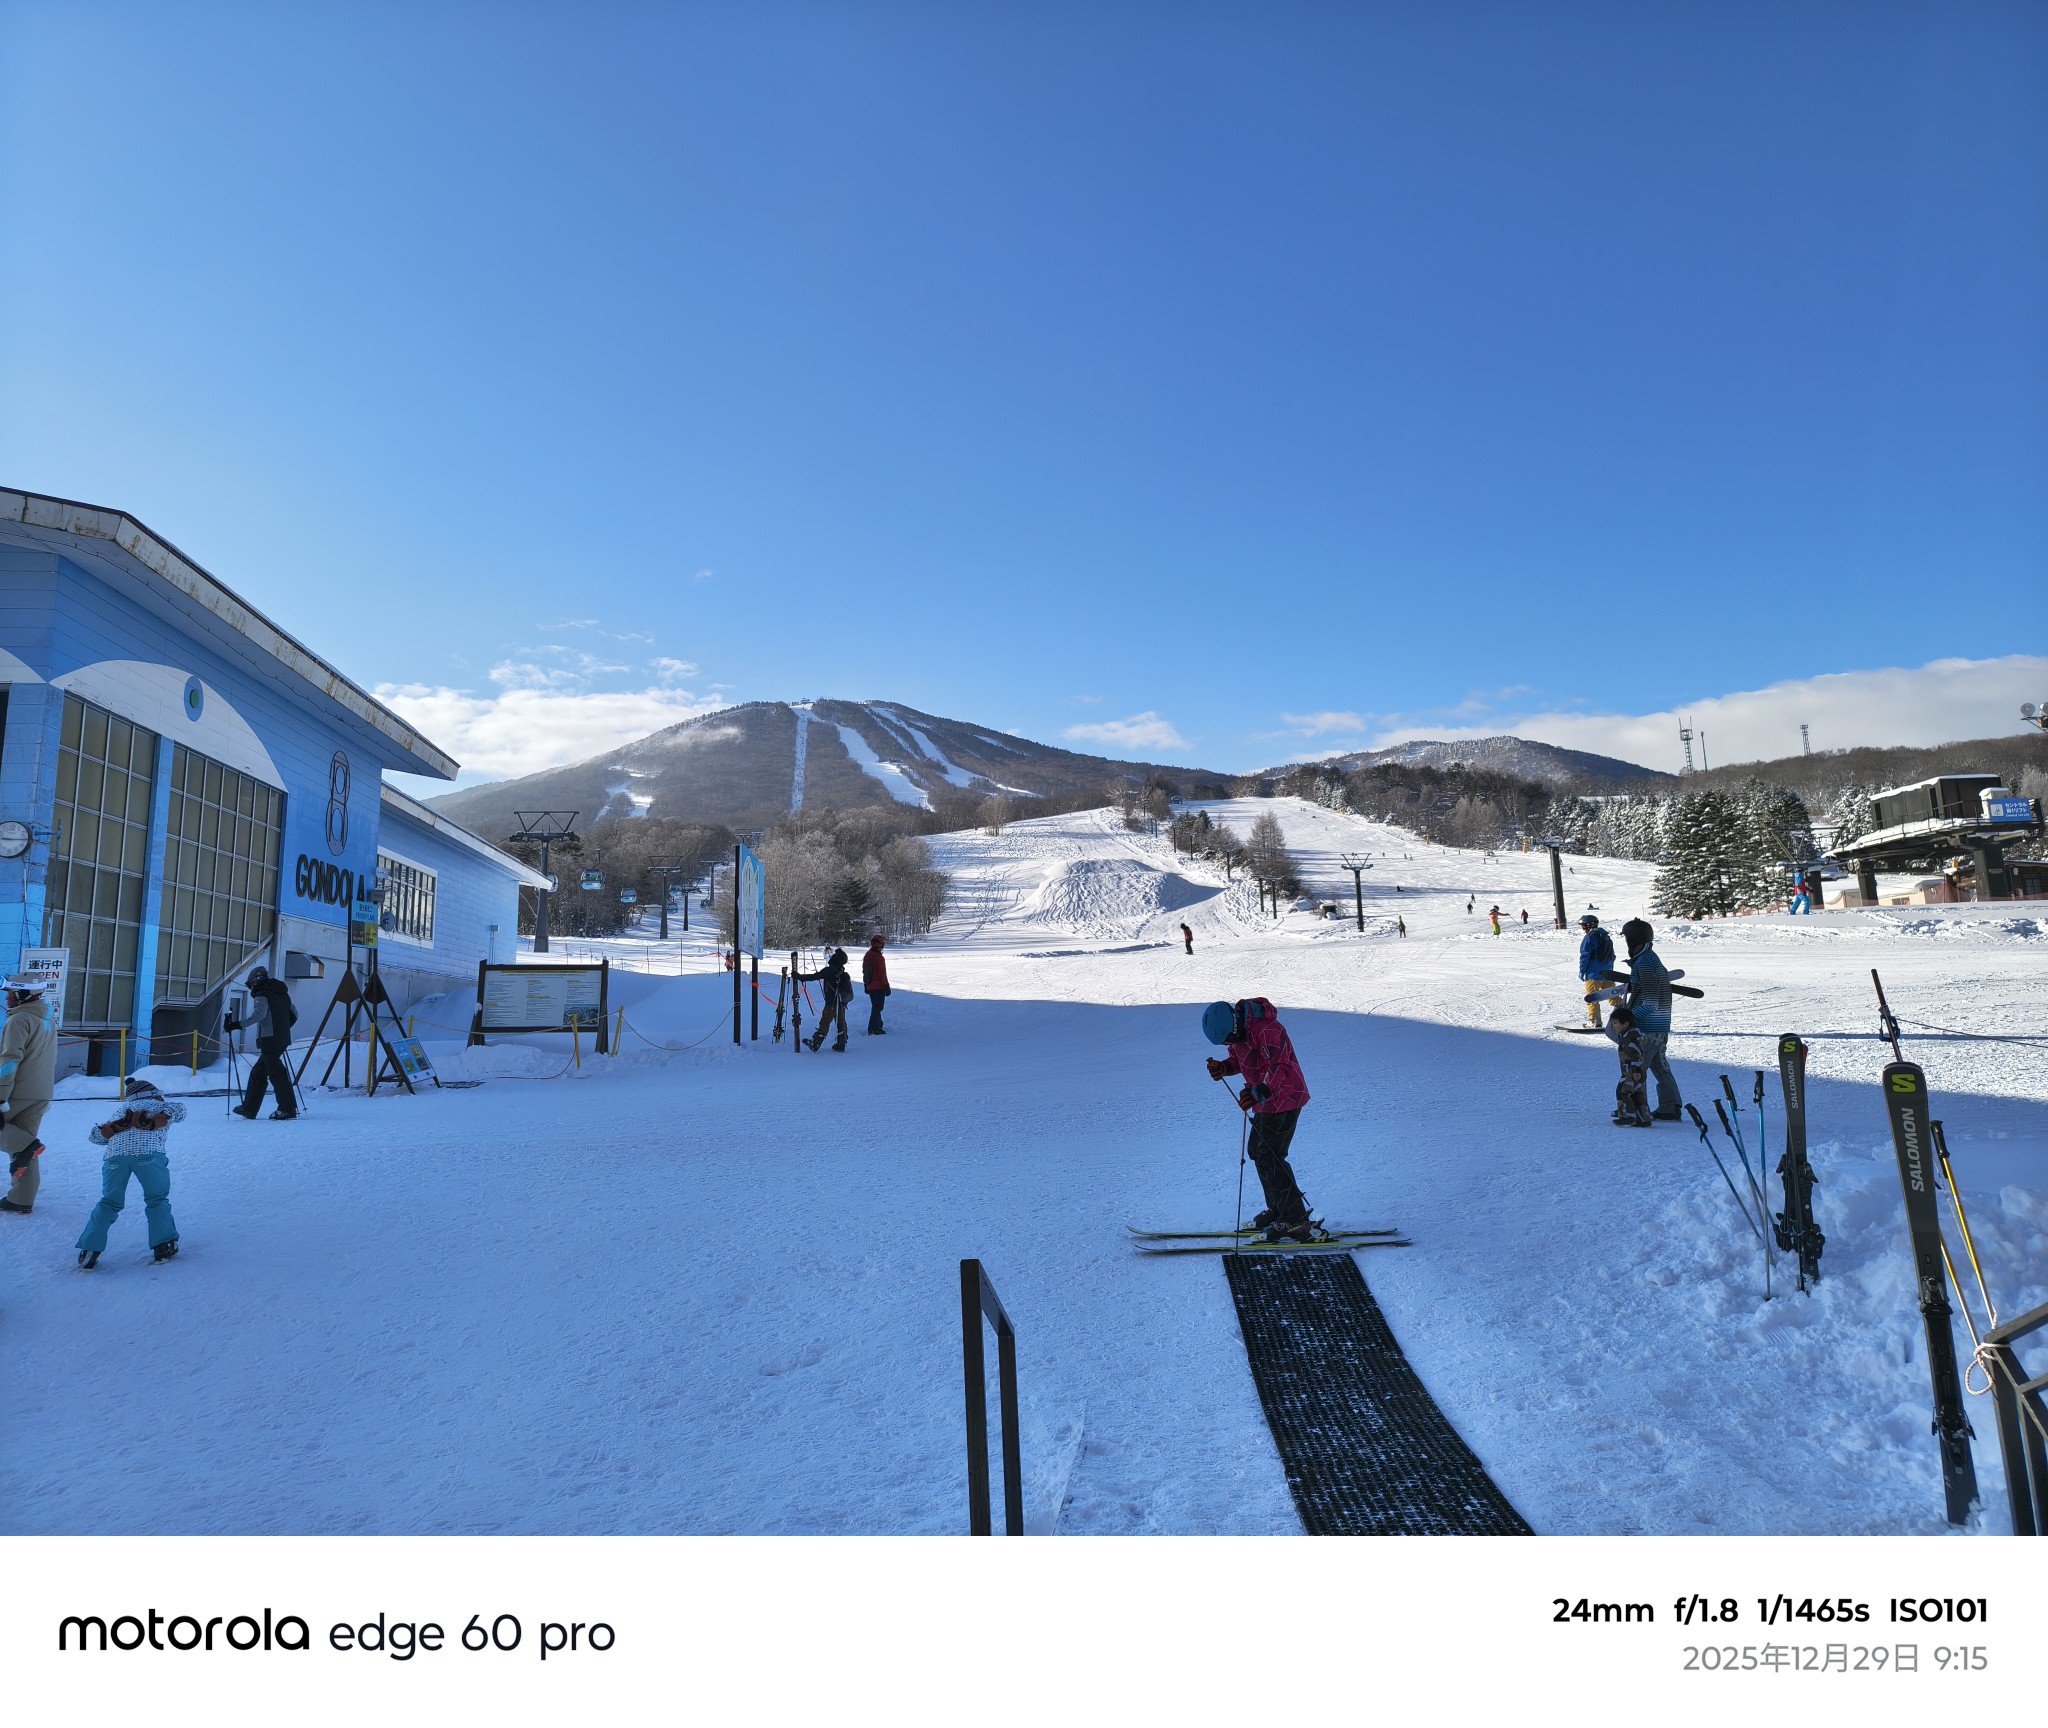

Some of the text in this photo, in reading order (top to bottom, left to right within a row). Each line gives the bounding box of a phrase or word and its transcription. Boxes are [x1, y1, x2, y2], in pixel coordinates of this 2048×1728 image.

[28, 959, 63, 970] 運行中
[1787, 1060, 1799, 1109] SALOMON
[1901, 1107, 1925, 1193] SALOMON
